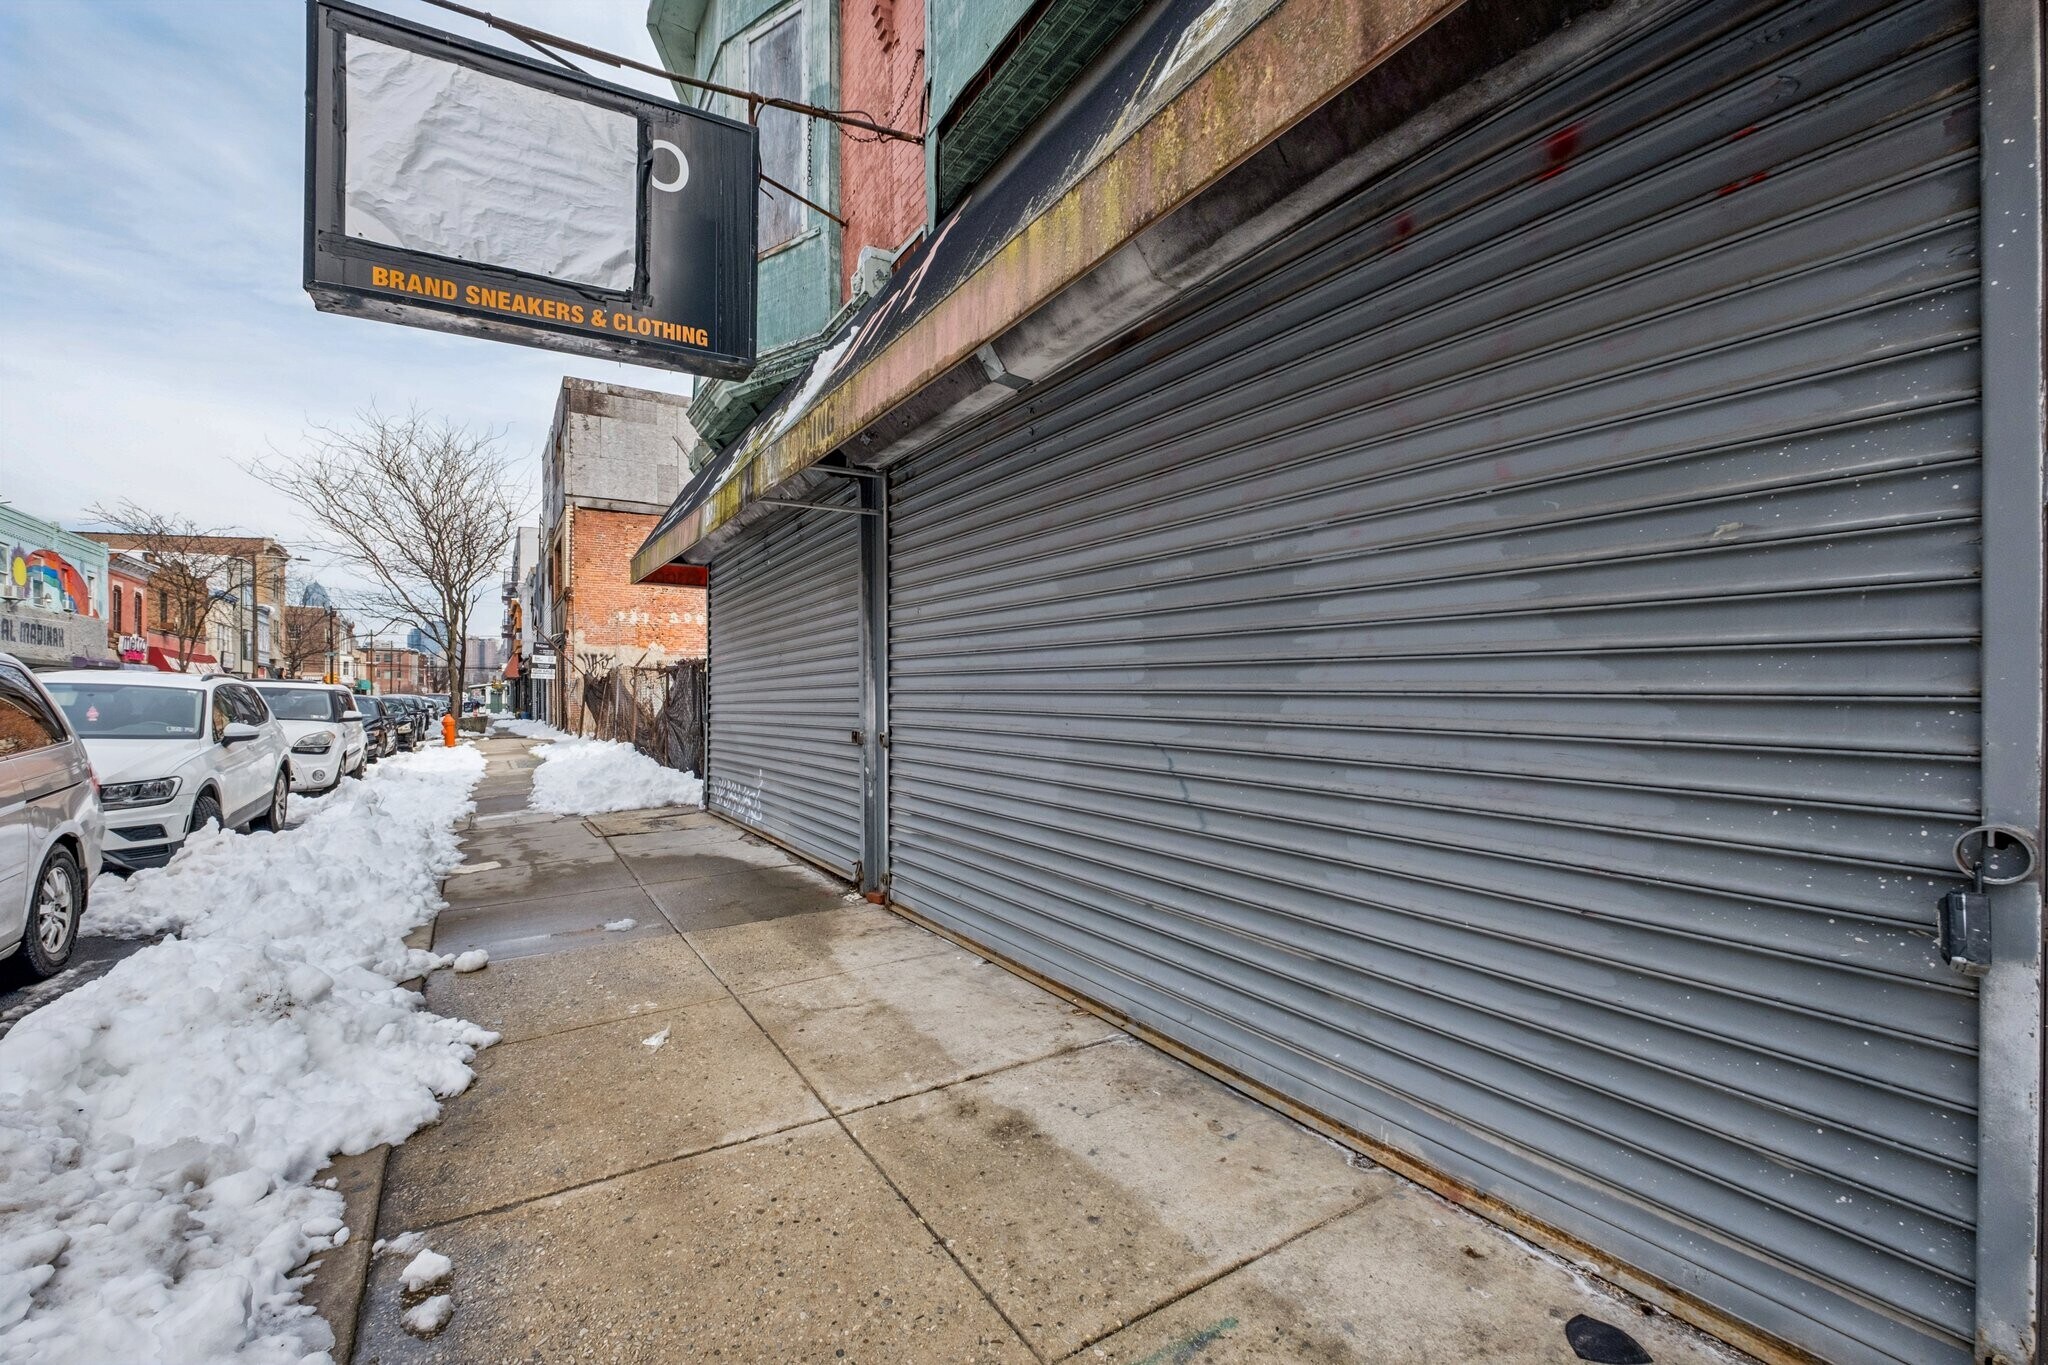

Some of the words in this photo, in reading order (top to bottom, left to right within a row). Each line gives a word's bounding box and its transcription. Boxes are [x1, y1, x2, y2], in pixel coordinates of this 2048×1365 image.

[372, 266, 458, 300] BRAND
[465, 285, 584, 324] SNEAKERS
[591, 309, 607, 328] &
[613, 313, 708, 347] CLOTHING
[1, 618, 16, 642] AL
[20, 621, 65, 648] MADINAH
[122, 637, 147, 651] metro
